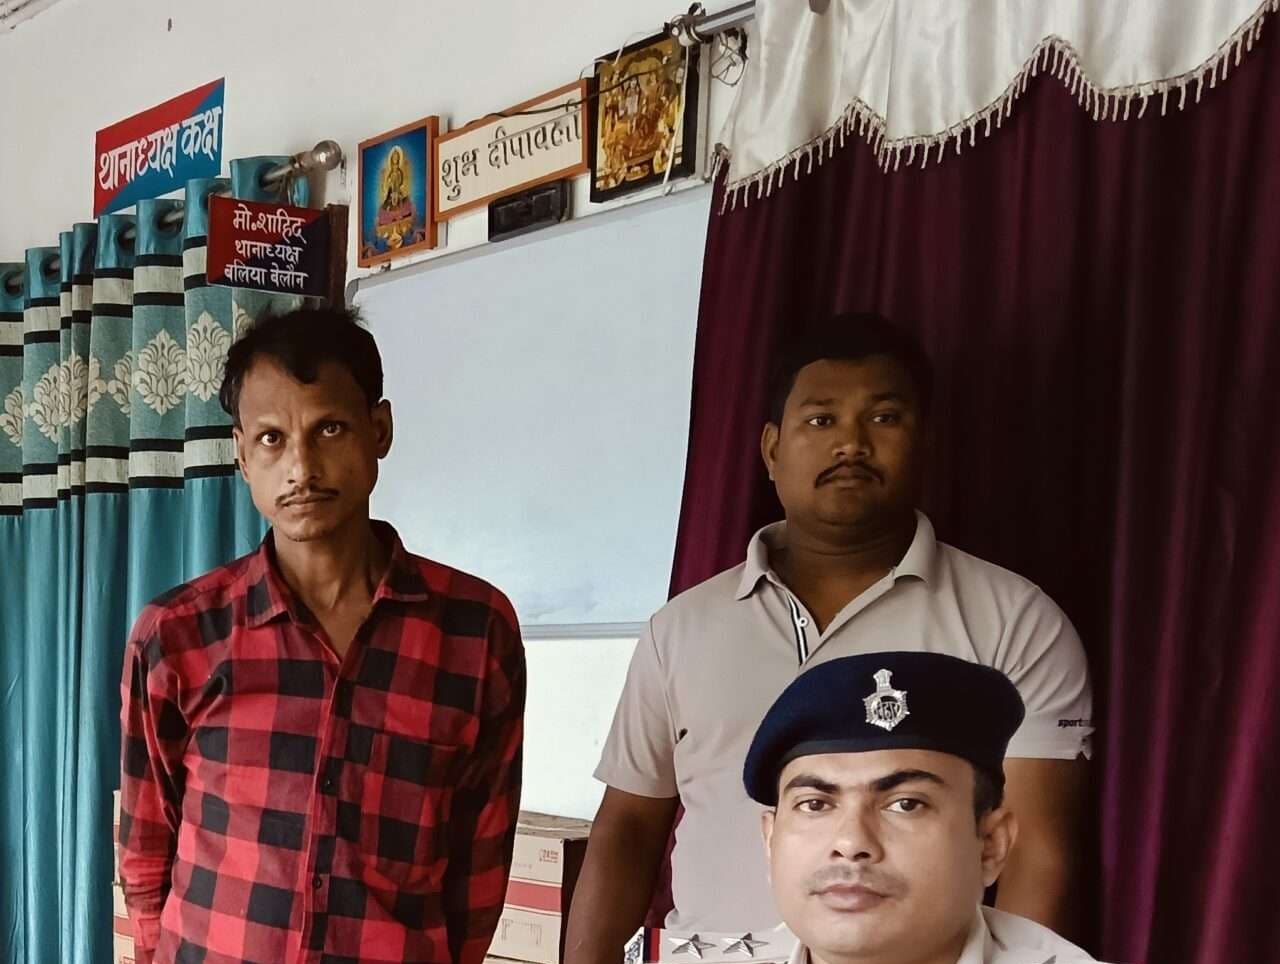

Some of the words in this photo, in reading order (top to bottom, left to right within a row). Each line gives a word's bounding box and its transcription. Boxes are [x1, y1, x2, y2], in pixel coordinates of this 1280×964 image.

[99, 122, 179, 190] थानाध्यक्ष
[180, 106, 222, 161] कक्ष
[441, 147, 480, 201] शुभ
[235, 240, 303, 264] थानाध्यक्ष
[224, 262, 268, 287] बलिया
